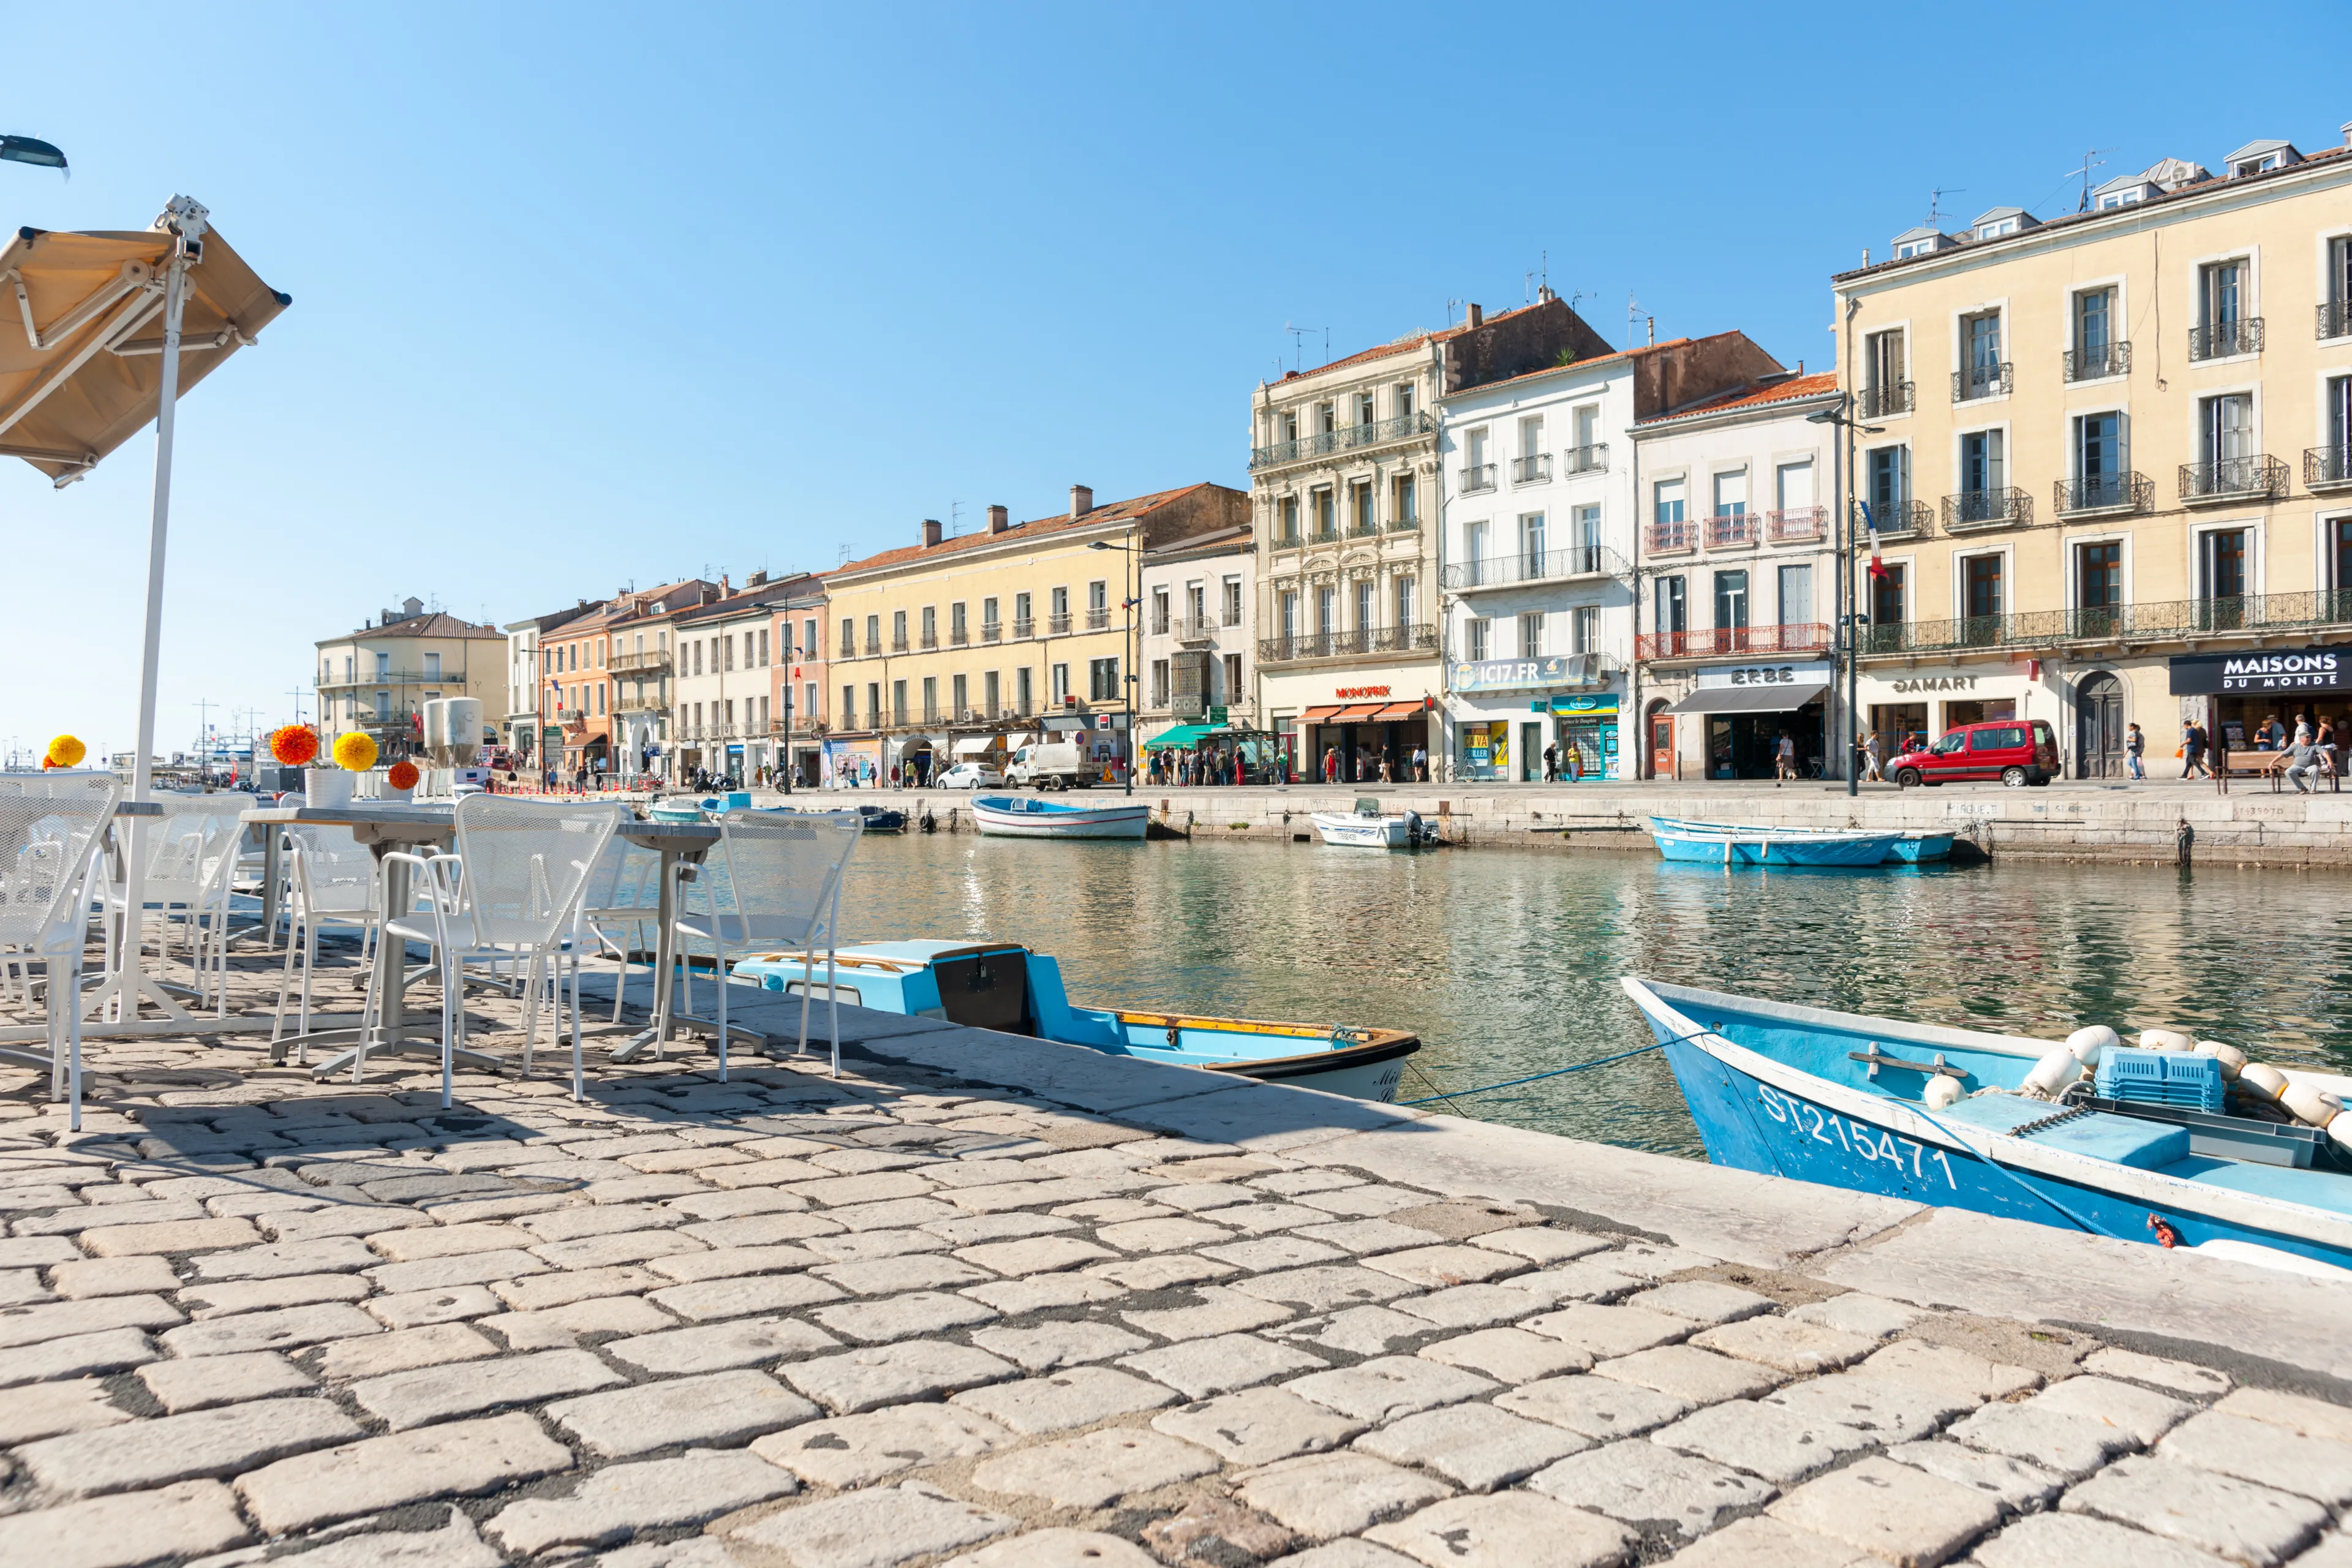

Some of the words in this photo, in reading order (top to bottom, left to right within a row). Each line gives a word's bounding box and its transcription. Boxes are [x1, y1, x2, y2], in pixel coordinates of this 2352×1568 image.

[1481, 662, 1539, 683] ICI7.FR
[2223, 654, 2337, 674] MAISONS
[1731, 666, 1794, 685] ERBE
[1891, 675, 1979, 693] DAMART
[2223, 679, 2247, 688] DU
[2263, 676, 2337, 687] MONDE
[1335, 685, 1390, 699] MONOPRIX
[1477, 736, 1487, 747] VA
[1758, 1084, 1957, 1190] ST215471
